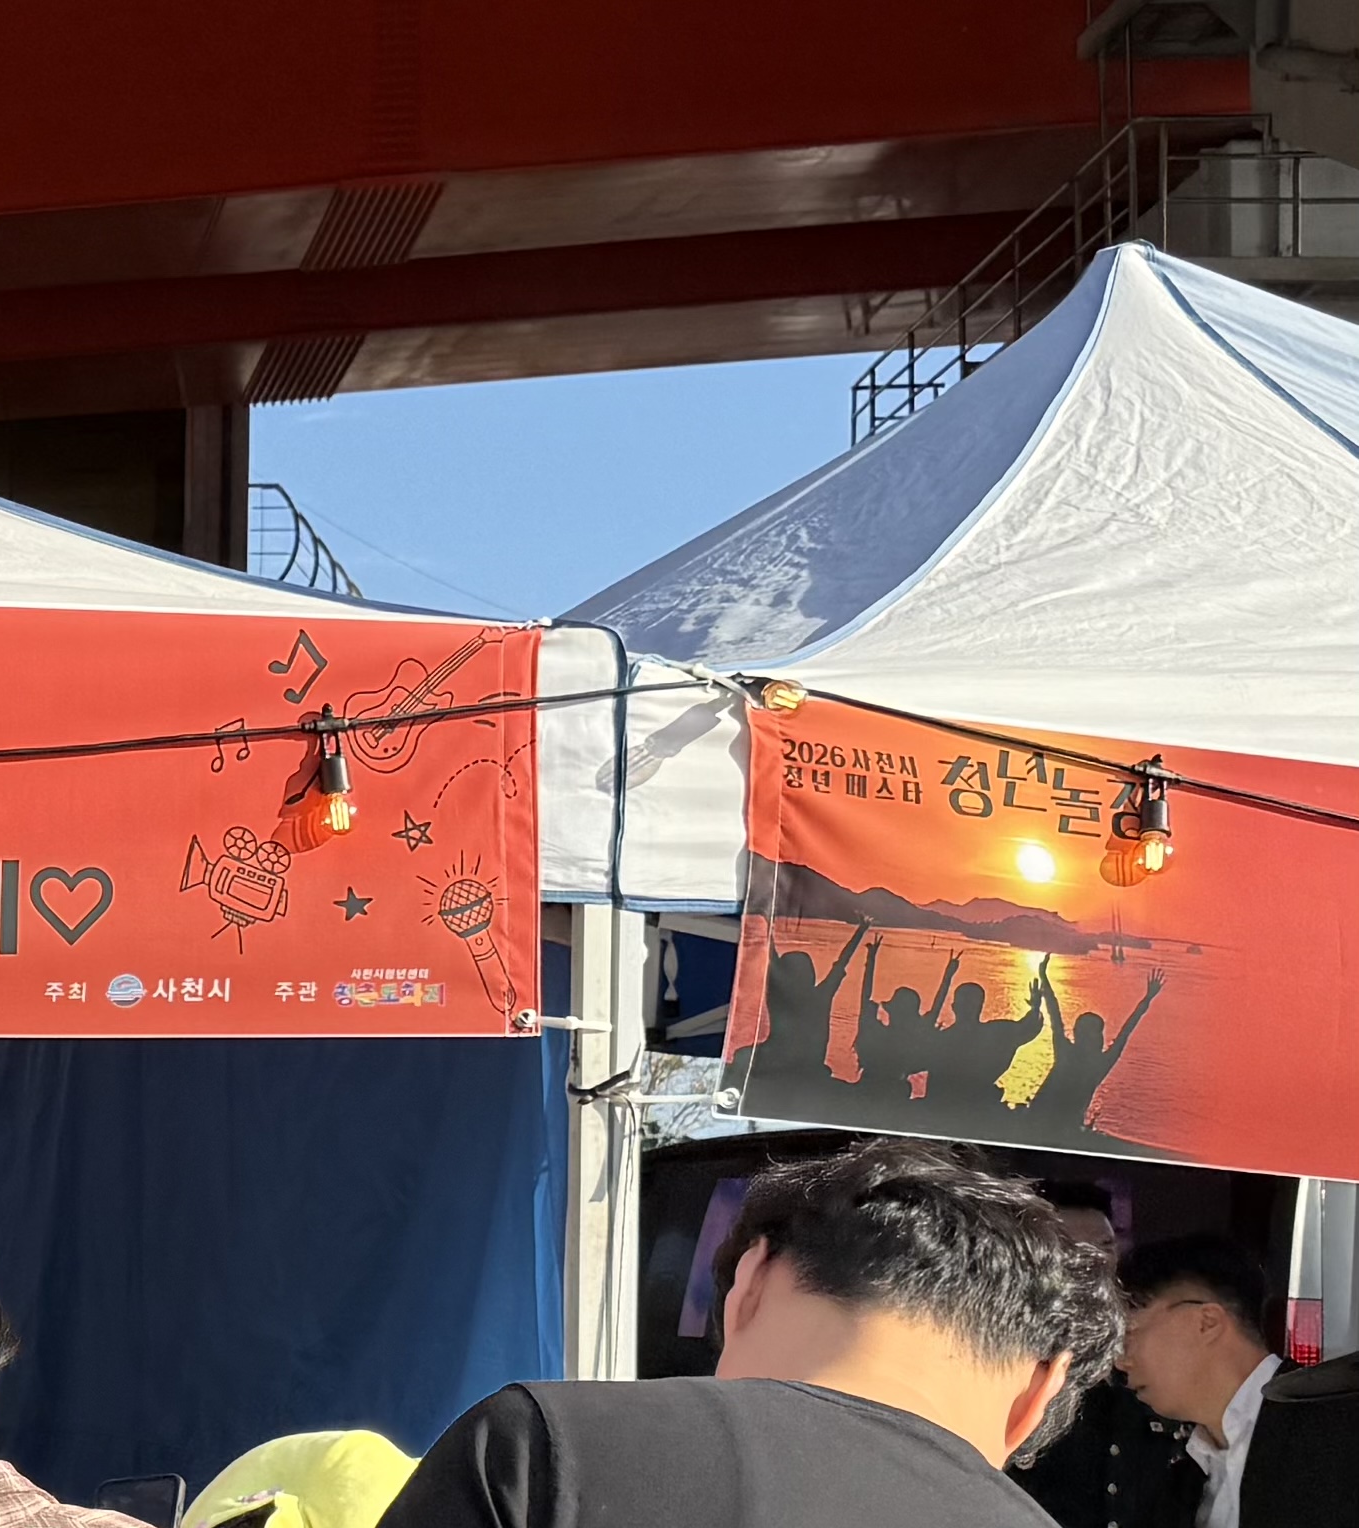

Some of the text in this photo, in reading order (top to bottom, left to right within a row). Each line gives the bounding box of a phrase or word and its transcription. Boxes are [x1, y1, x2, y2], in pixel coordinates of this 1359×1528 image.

[782, 739, 919, 780] 2026 사천시
[782, 764, 924, 805] 청년 페스타
[44, 976, 231, 1003] 주최 사천시
[274, 980, 318, 1003] 주관
